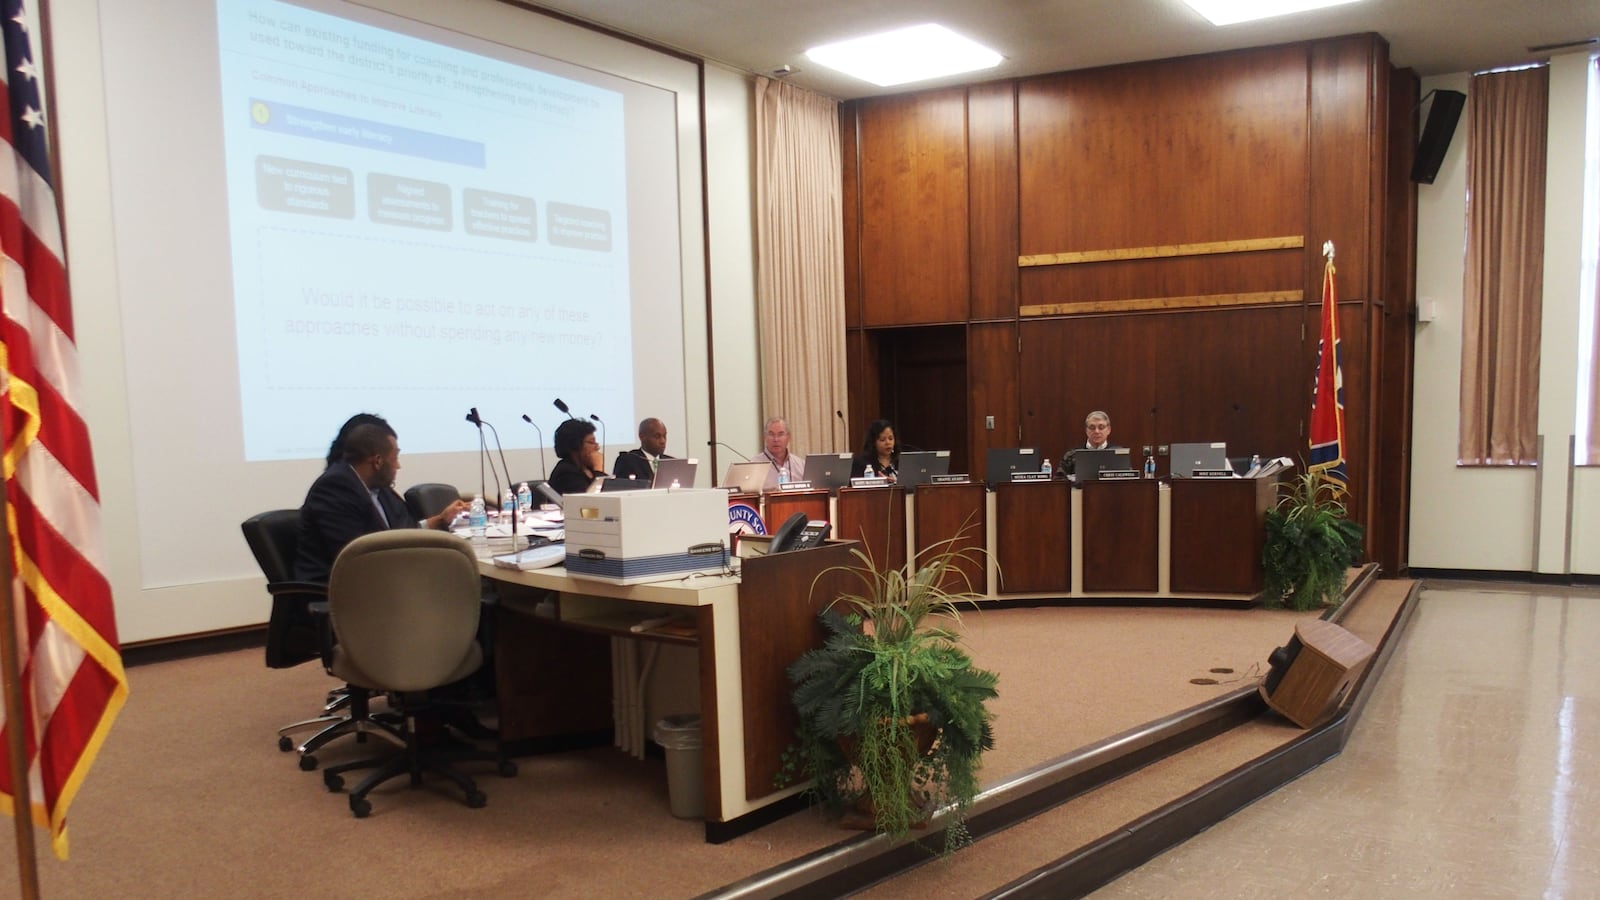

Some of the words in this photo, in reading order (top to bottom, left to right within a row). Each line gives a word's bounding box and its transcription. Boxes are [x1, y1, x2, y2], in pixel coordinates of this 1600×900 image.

[248, 9, 275, 26] How
[280, 20, 301, 33] can
[305, 25, 350, 48] existing
[354, 35, 394, 58] funding
[396, 47, 411, 60] for
[250, 31, 279, 47] used
[284, 39, 323, 57] toward
[327, 48, 345, 62] the
[301, 287, 353, 308] Would
[360, 290, 368, 308] it
[373, 292, 391, 310] be
[396, 295, 455, 316] possible
[458, 298, 473, 315] to
[498, 304, 514, 318] on
[519, 305, 540, 323] any
[544, 304, 555, 321] of
[558, 305, 591, 323] these
[285, 319, 379, 341] approaches
[383, 319, 437, 340] without
[440, 323, 501, 346] spending
[504, 328, 527, 348] any
[531, 331, 555, 345] new
[729, 508, 753, 522] UNTY
